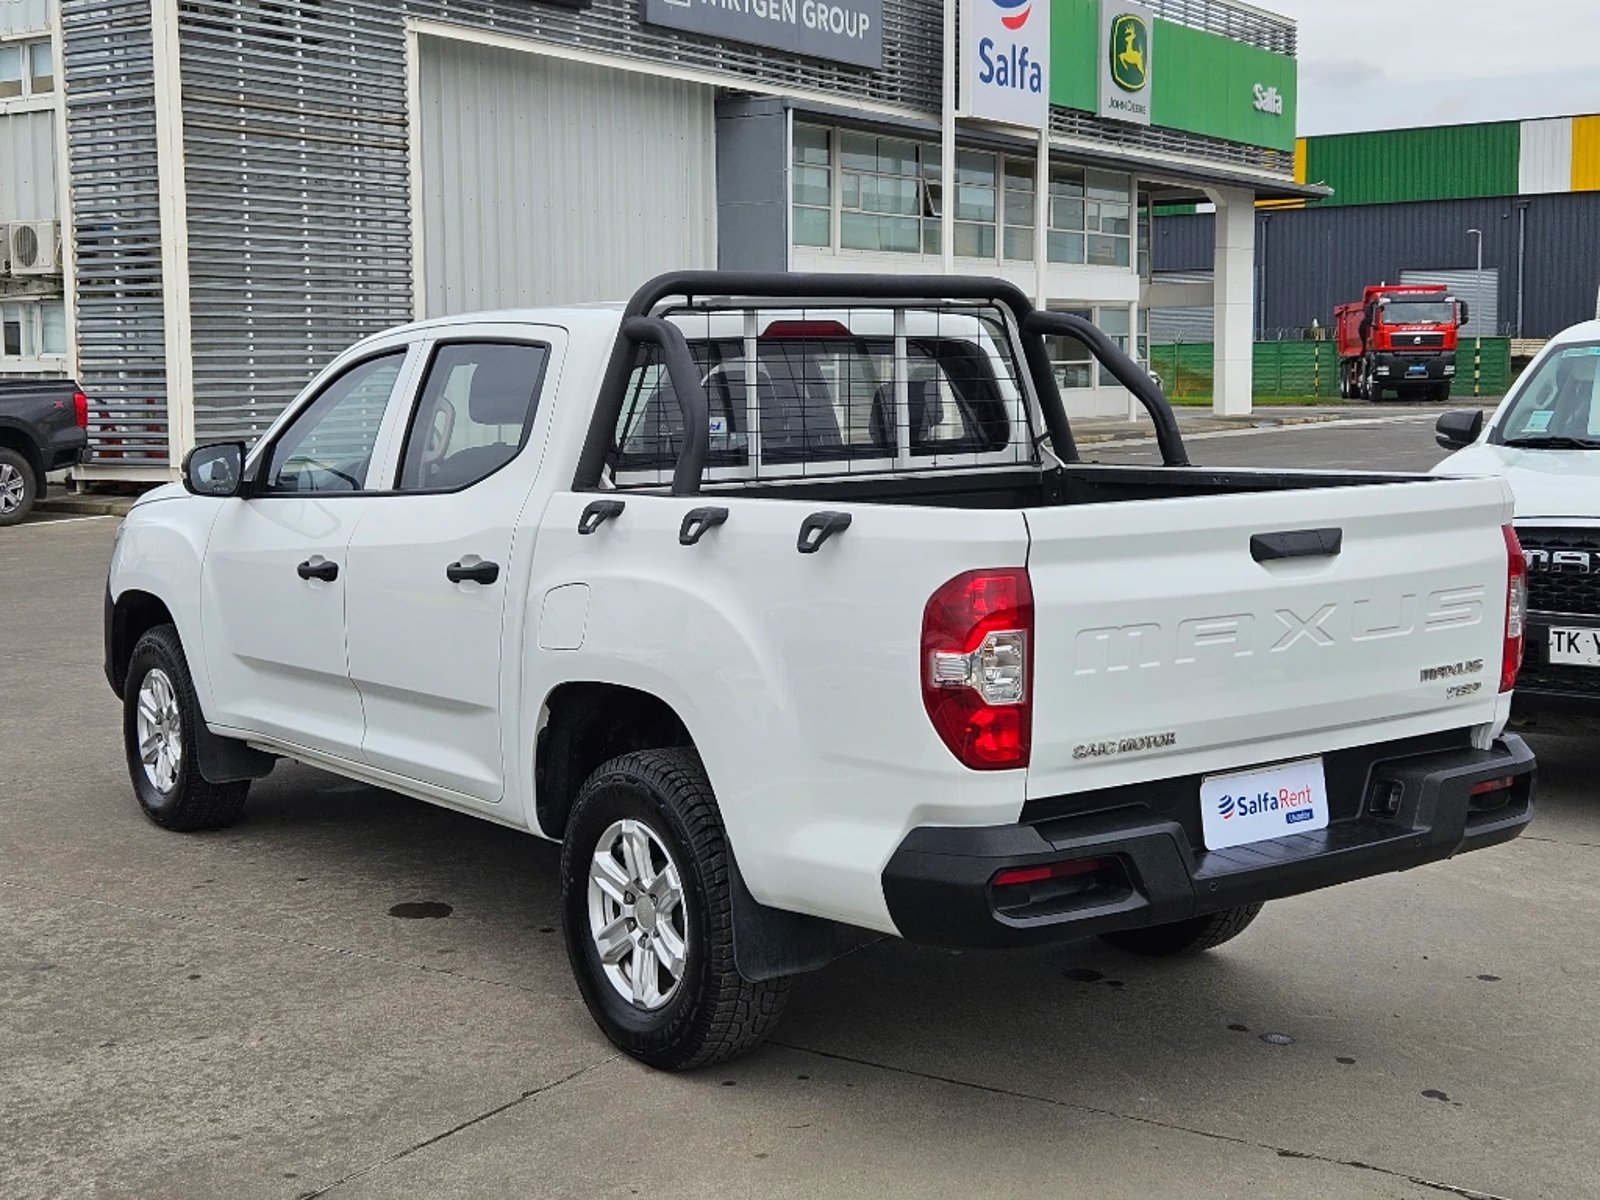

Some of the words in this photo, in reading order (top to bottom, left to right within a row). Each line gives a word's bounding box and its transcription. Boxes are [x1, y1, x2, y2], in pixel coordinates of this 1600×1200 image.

[803, 0, 870, 40] GROUP
[978, 37, 1042, 94] Salfa
[1252, 83, 1283, 115] Salfa
[1522, 549, 1600, 574] MA
[1074, 584, 1486, 676] MAXUS
[1419, 658, 1484, 682] MAXUS
[1072, 740, 1117, 759] SAIC
[1118, 731, 1177, 753] MOTOR
[1237, 783, 1313, 817] SalfaRent
